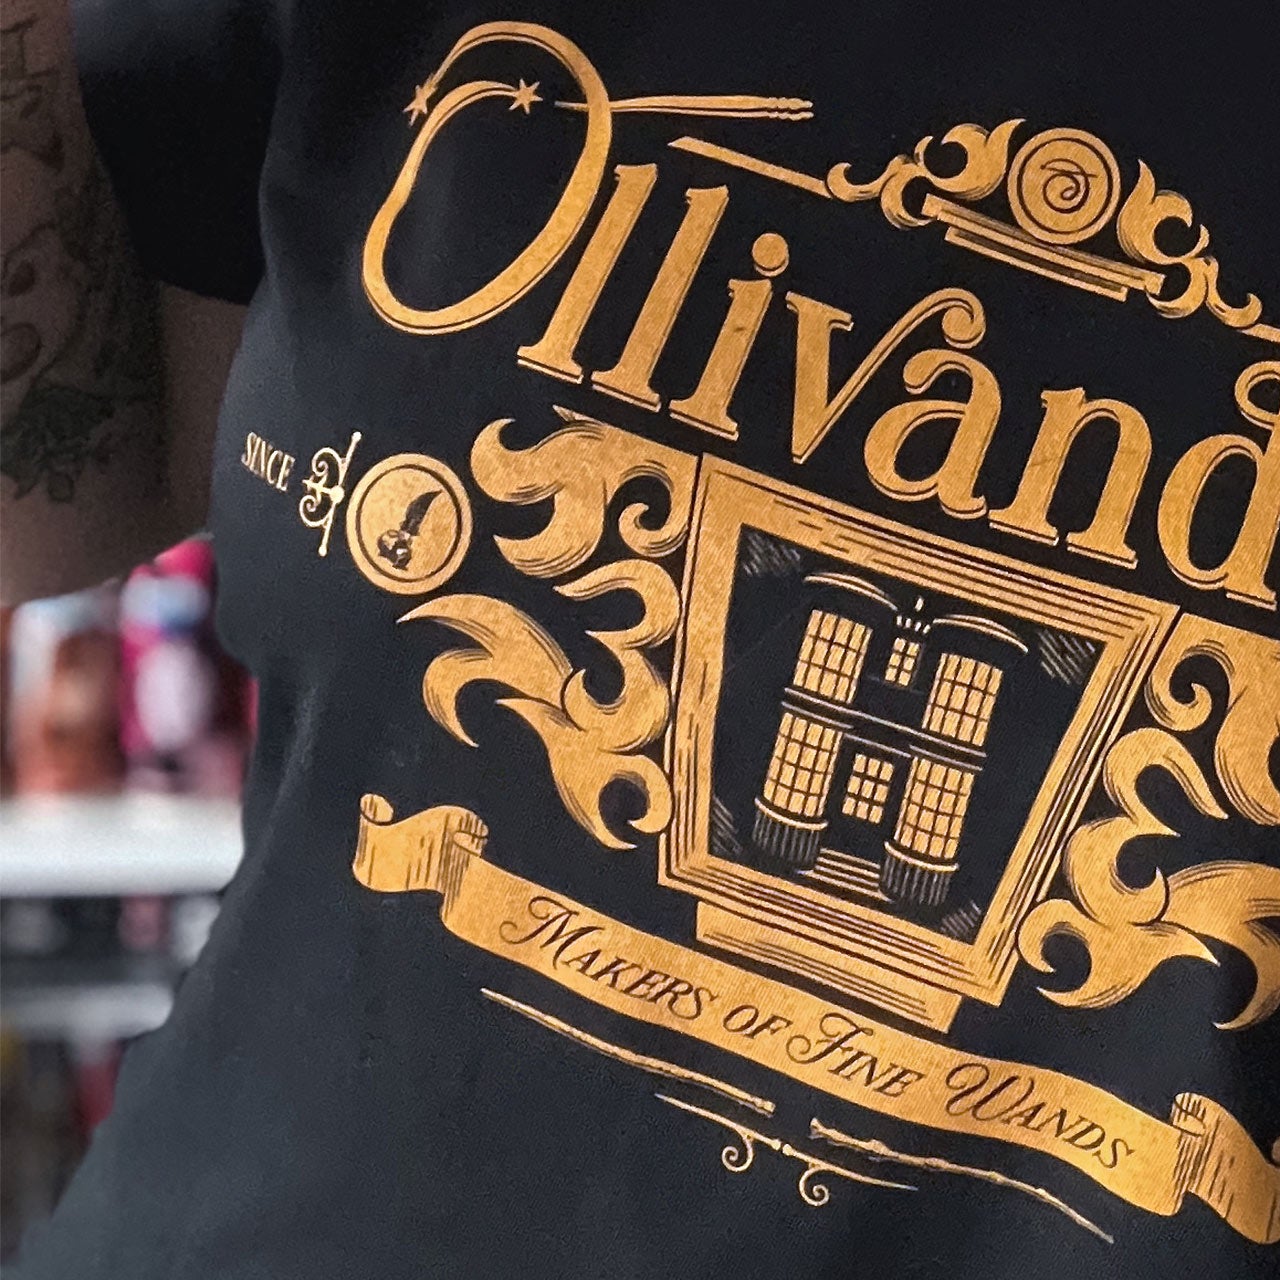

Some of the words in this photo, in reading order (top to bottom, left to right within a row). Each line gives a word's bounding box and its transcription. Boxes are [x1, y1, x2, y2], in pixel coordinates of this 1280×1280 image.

[241, 431, 296, 492] SINCE
[499, 895, 719, 1021] MAKERS
[722, 1004, 794, 1040] OF
[785, 1012, 926, 1099] FINE
[944, 1062, 1136, 1170] WANDS
